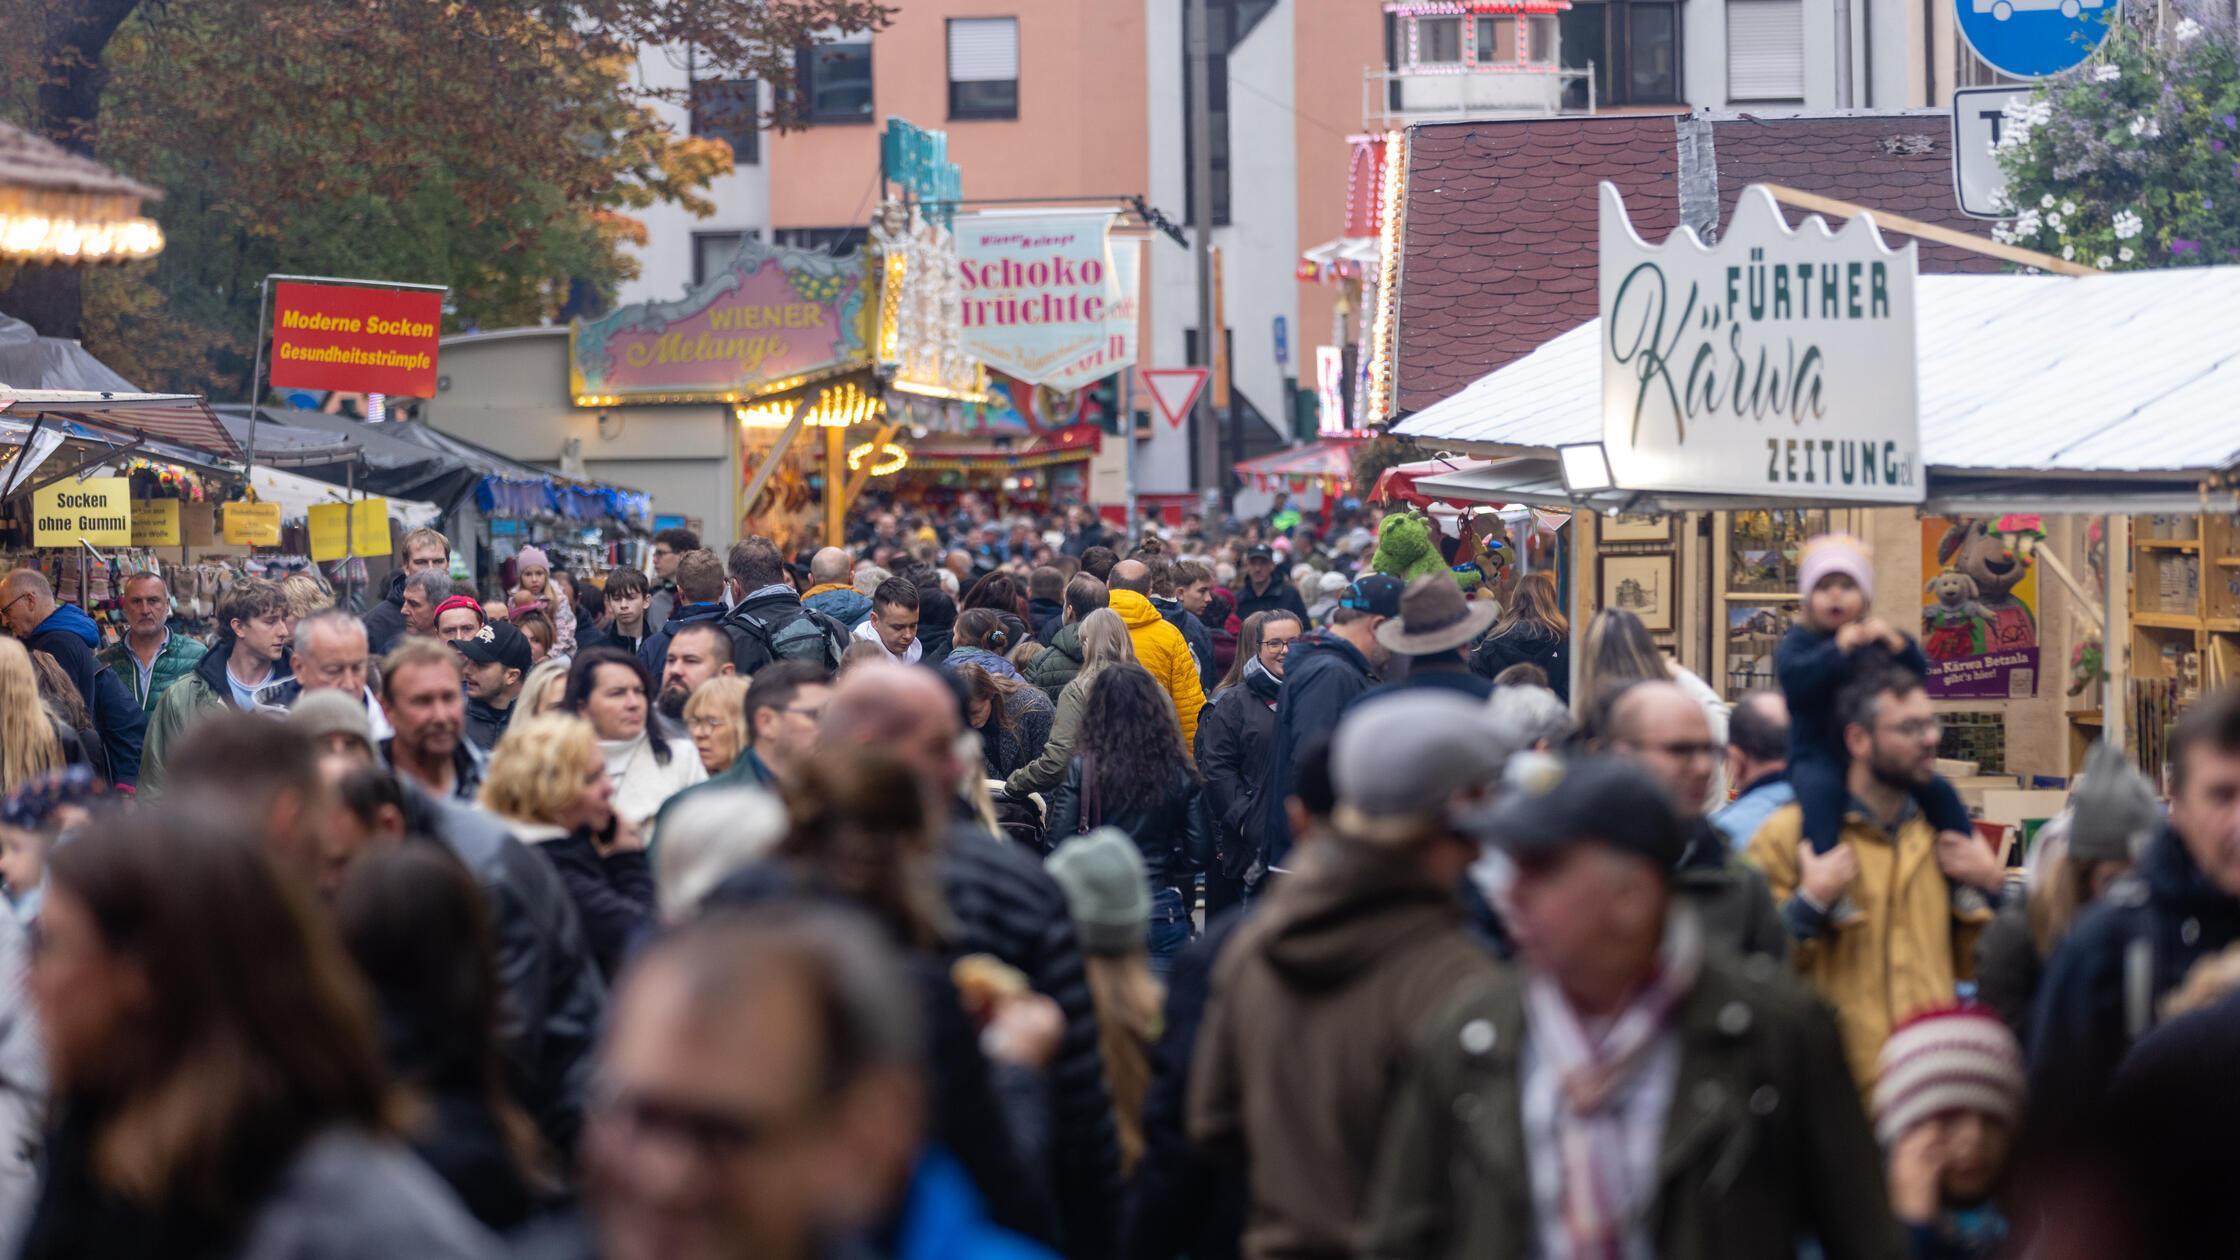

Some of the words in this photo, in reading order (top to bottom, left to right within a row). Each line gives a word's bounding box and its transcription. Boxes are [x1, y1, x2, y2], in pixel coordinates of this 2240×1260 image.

[960, 256, 1104, 290] Schoko
[1727, 246, 1890, 322] FÜRTHER
[281, 309, 362, 333] Moderne
[366, 315, 434, 338] Socken
[709, 303, 826, 331] WIENER
[961, 293, 1105, 328] früchte
[279, 341, 431, 371] Gesundheitsstrümpfe
[625, 331, 791, 372] Melange
[1610, 261, 1827, 448] Kärwa
[1767, 437, 1899, 485] ZEITUNG
[57, 492, 108, 508] Socken
[38, 515, 72, 531] ohne
[79, 515, 126, 531] Gummi
[1943, 660, 1983, 674] Kärwa
[1984, 652, 2030, 668] Betzala
